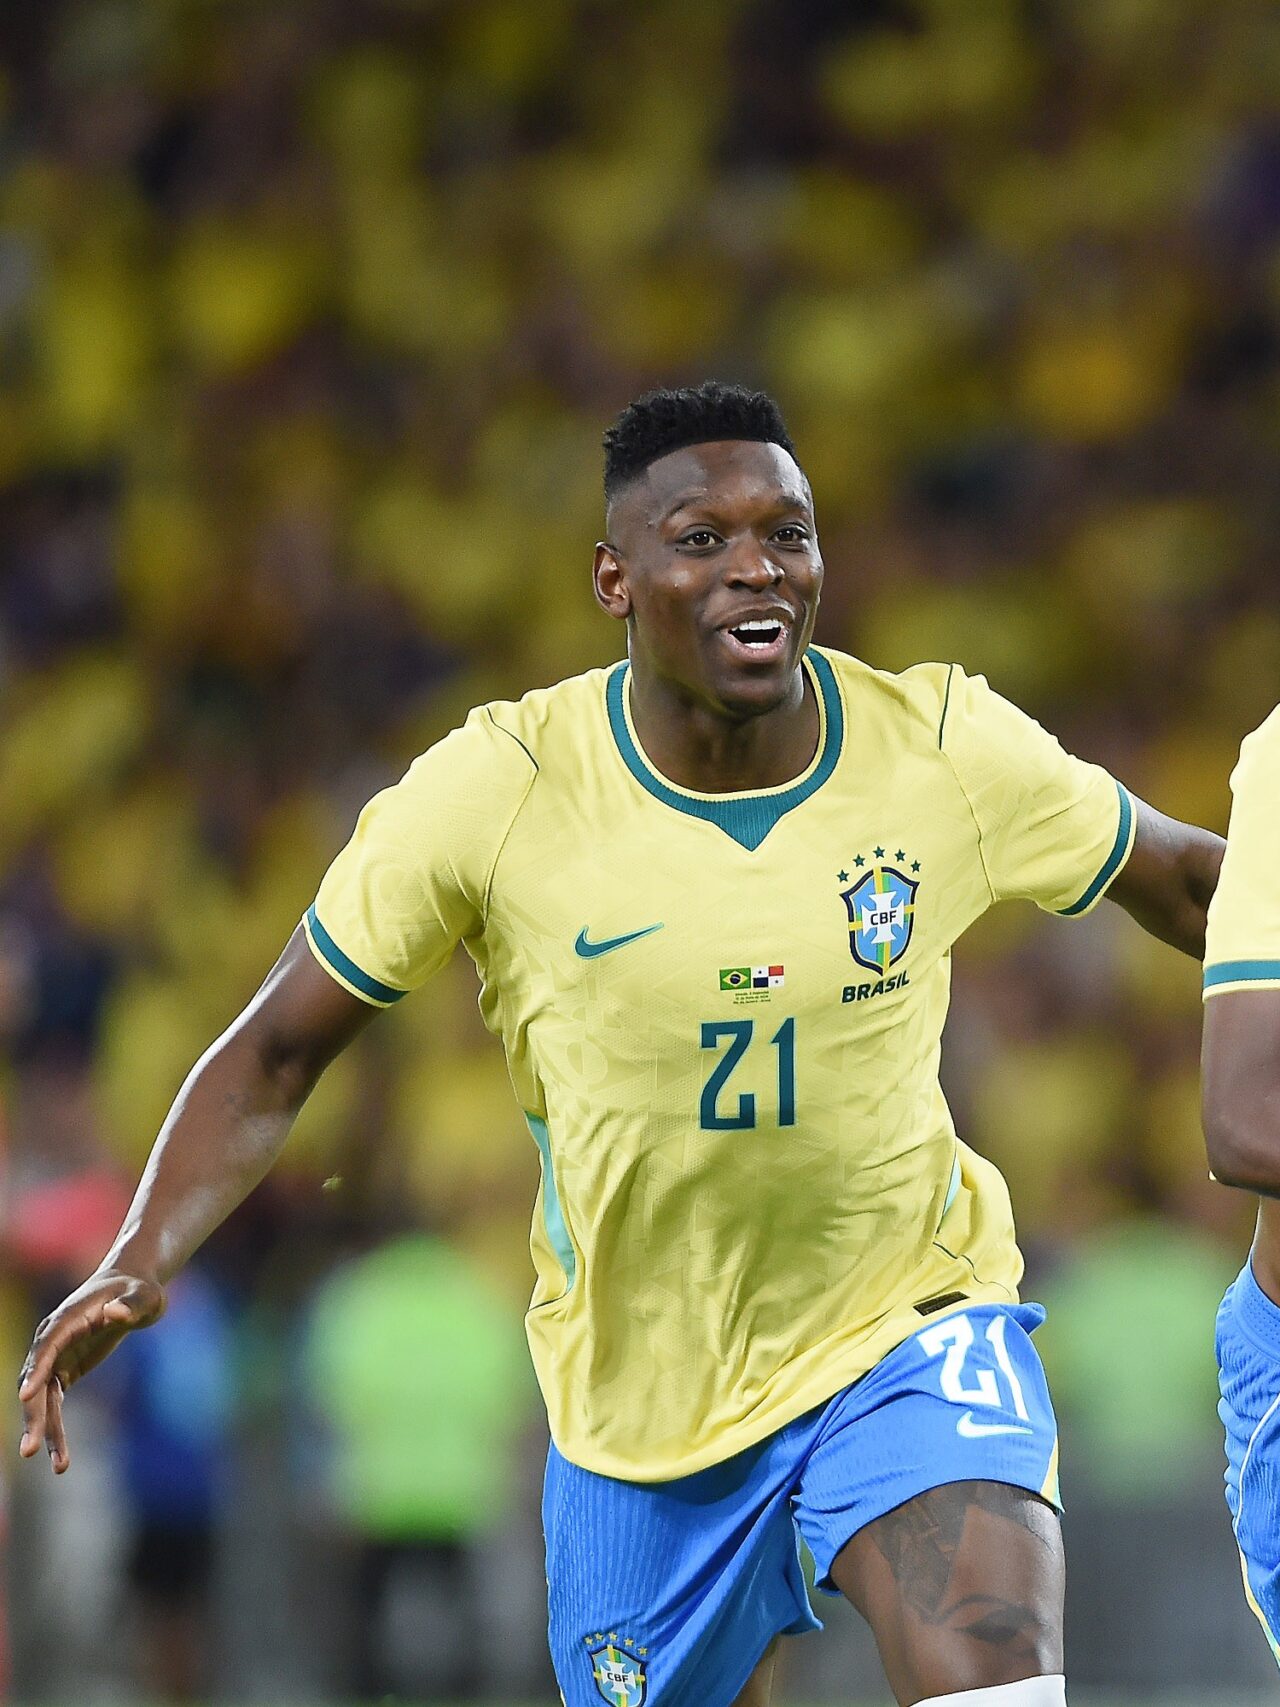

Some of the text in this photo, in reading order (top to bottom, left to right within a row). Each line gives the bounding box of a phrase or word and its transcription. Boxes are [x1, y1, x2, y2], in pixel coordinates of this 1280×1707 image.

[870, 910, 897, 925] CBF
[841, 970, 911, 1003] BRASIL
[700, 1017, 795, 1129] 21
[917, 1314, 1029, 1421] 21
[607, 1673, 629, 1683] CBF
